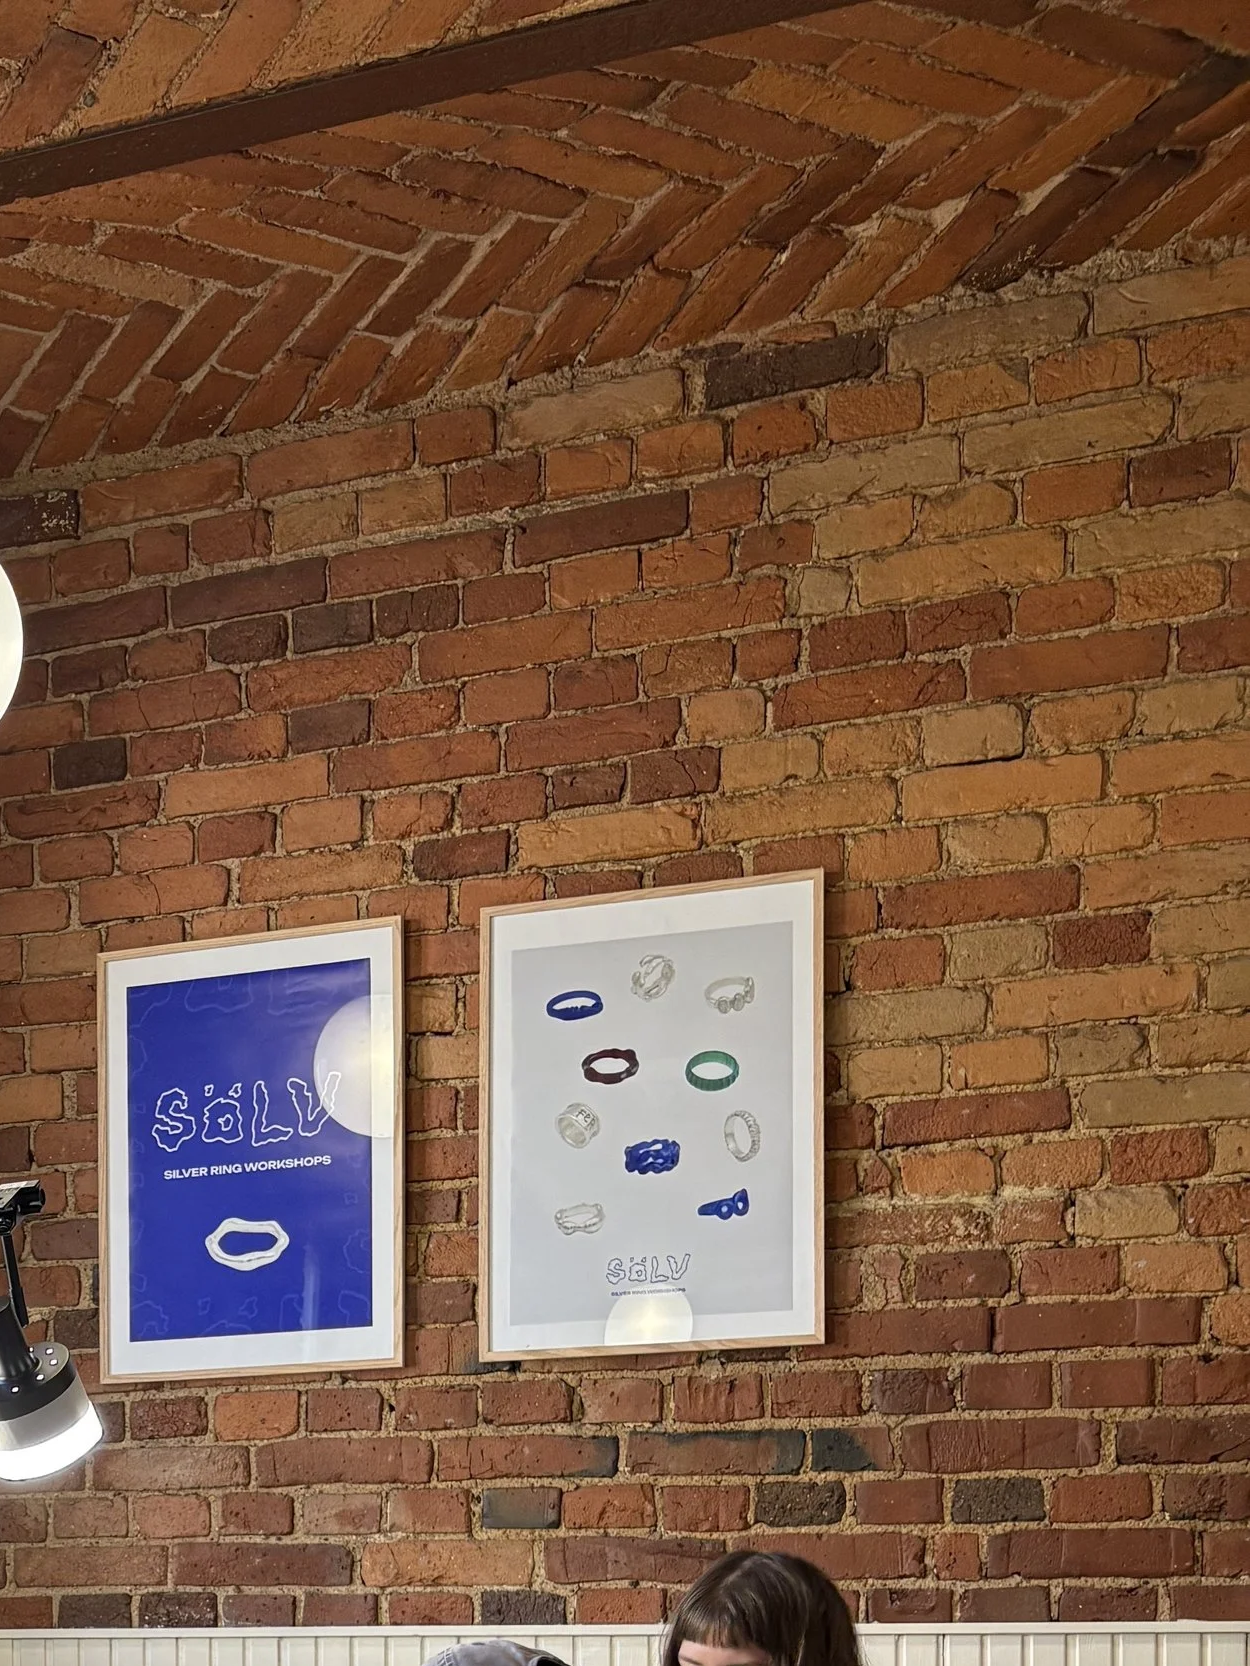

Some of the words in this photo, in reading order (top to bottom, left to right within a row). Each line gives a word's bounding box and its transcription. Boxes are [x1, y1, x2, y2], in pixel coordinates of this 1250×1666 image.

[163, 1165, 209, 1180] SILVER
[210, 1163, 242, 1176] RING
[245, 1155, 332, 1172] WORKSHOPS
